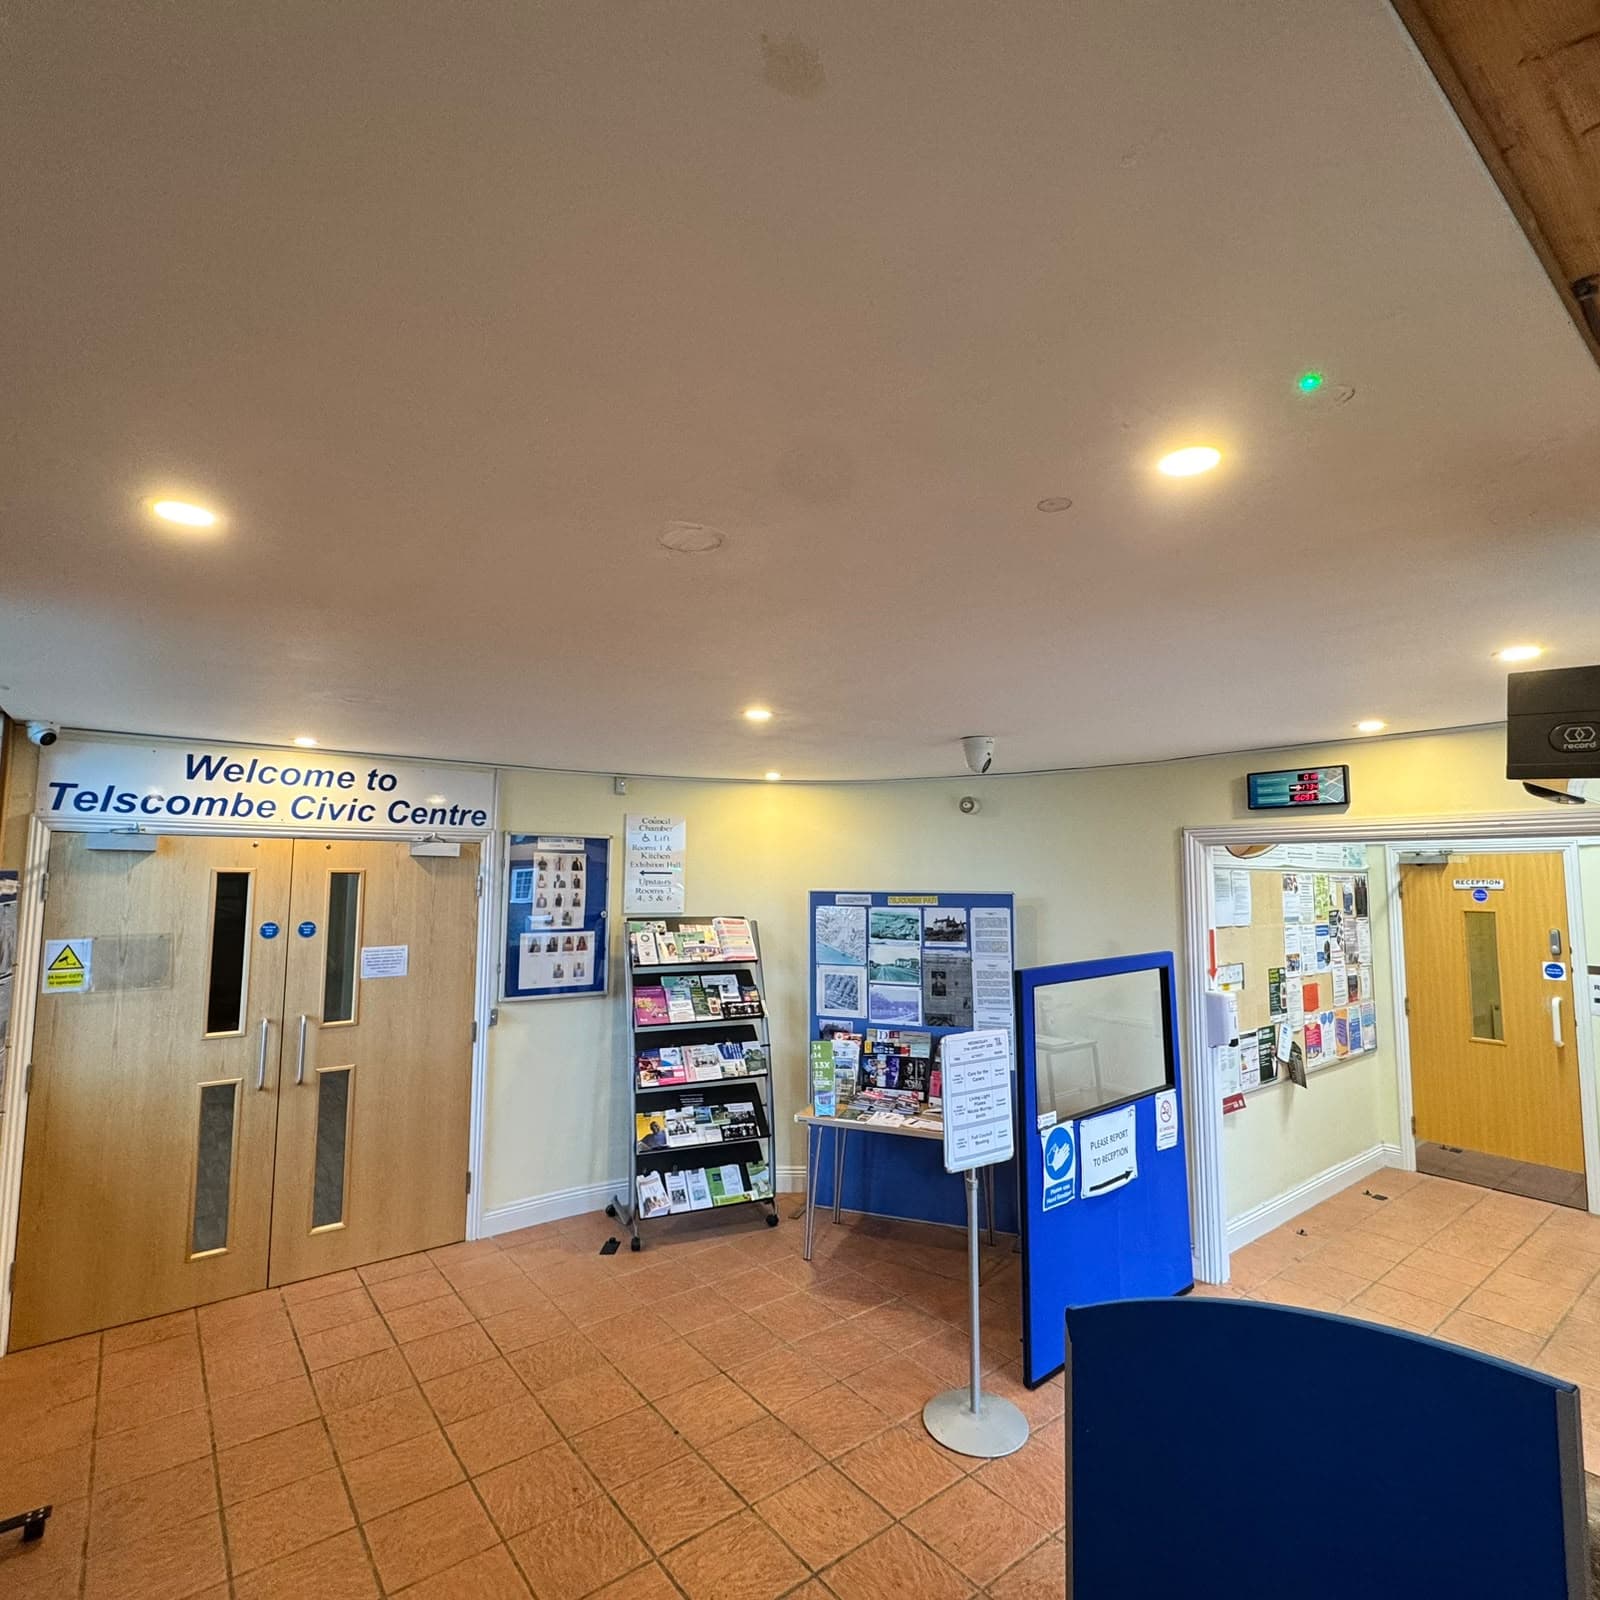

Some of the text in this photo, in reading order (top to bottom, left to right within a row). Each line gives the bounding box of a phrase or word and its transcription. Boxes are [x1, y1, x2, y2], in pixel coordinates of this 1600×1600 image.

[1563, 741, 1597, 750] record
[186, 753, 398, 792] Welcome to
[49, 781, 488, 827] Telscombe Civic Centre
[641, 817, 671, 825] Council
[639, 824, 673, 832] Chamber
[654, 834, 670, 842] Lift
[641, 851, 671, 860] Kitchen
[639, 878, 672, 887] Upstairs
[635, 887, 664, 895] Rooms
[1090, 1128, 1129, 1151] PLEASE REPORT
[1093, 1145, 1129, 1167] TO RECEPTION
